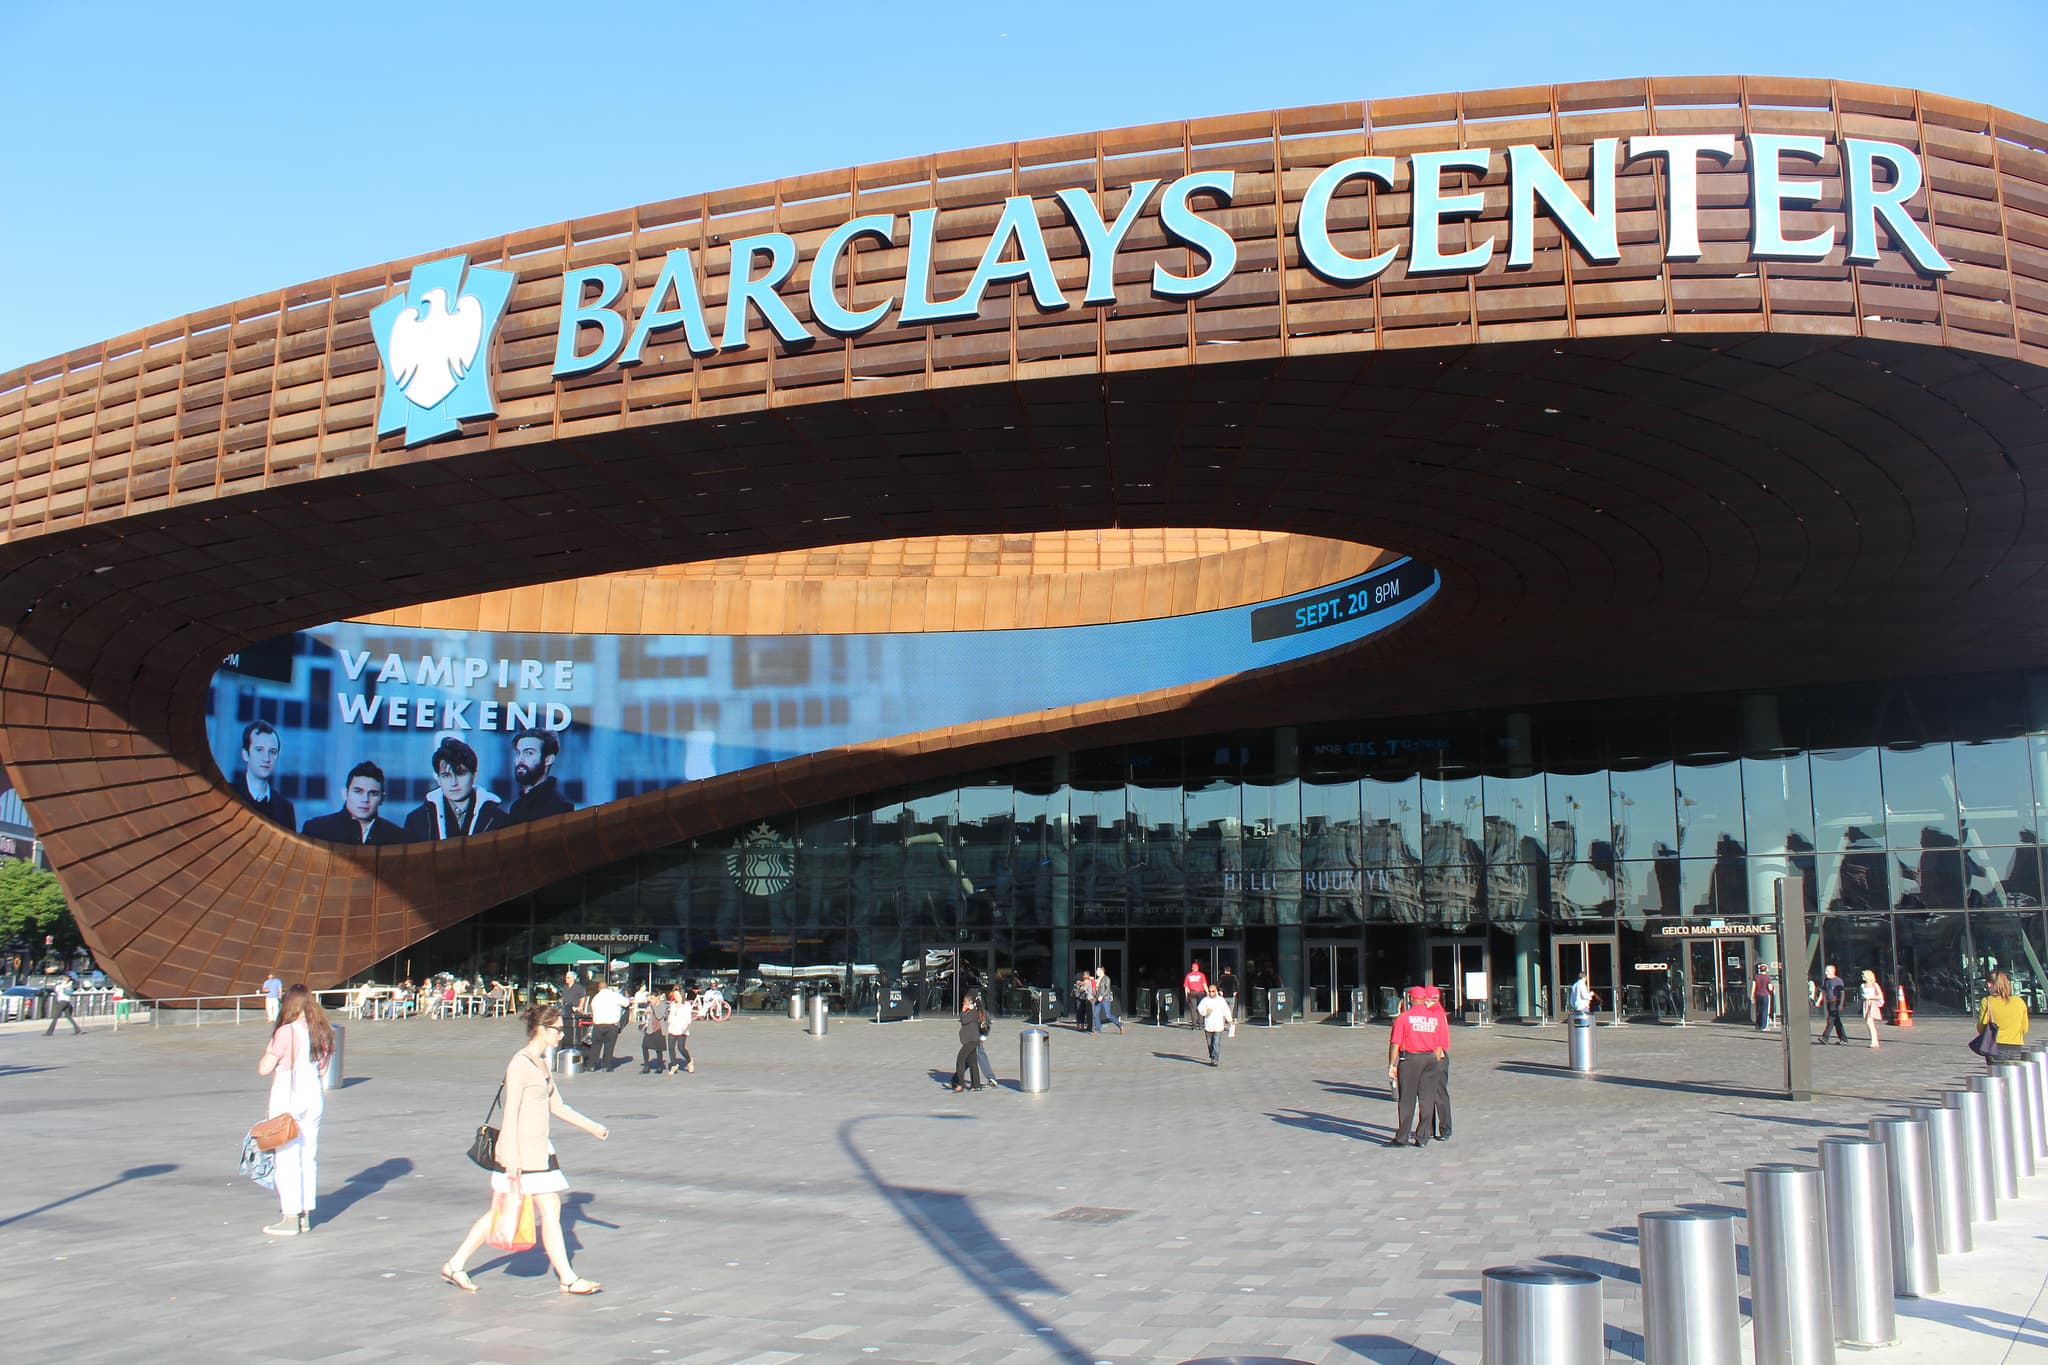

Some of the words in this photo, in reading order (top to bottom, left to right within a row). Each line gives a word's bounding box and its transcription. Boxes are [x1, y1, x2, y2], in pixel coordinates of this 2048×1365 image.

[550, 169, 1237, 379] BARCLAYS
[1296, 132, 1954, 283] CENTER
[1295, 597, 1344, 629] SEPT.
[1347, 590, 1368, 616] 20
[1375, 578, 1400, 604] 8PM
[339, 649, 574, 690] VAMPIRE
[337, 692, 573, 733] WEEKEND
[564, 933, 615, 941] STARBUCKS
[1661, 926, 1690, 935] GEICO
[1691, 925, 1717, 935] MAIN
[1719, 924, 1773, 934] ENTRANCE
